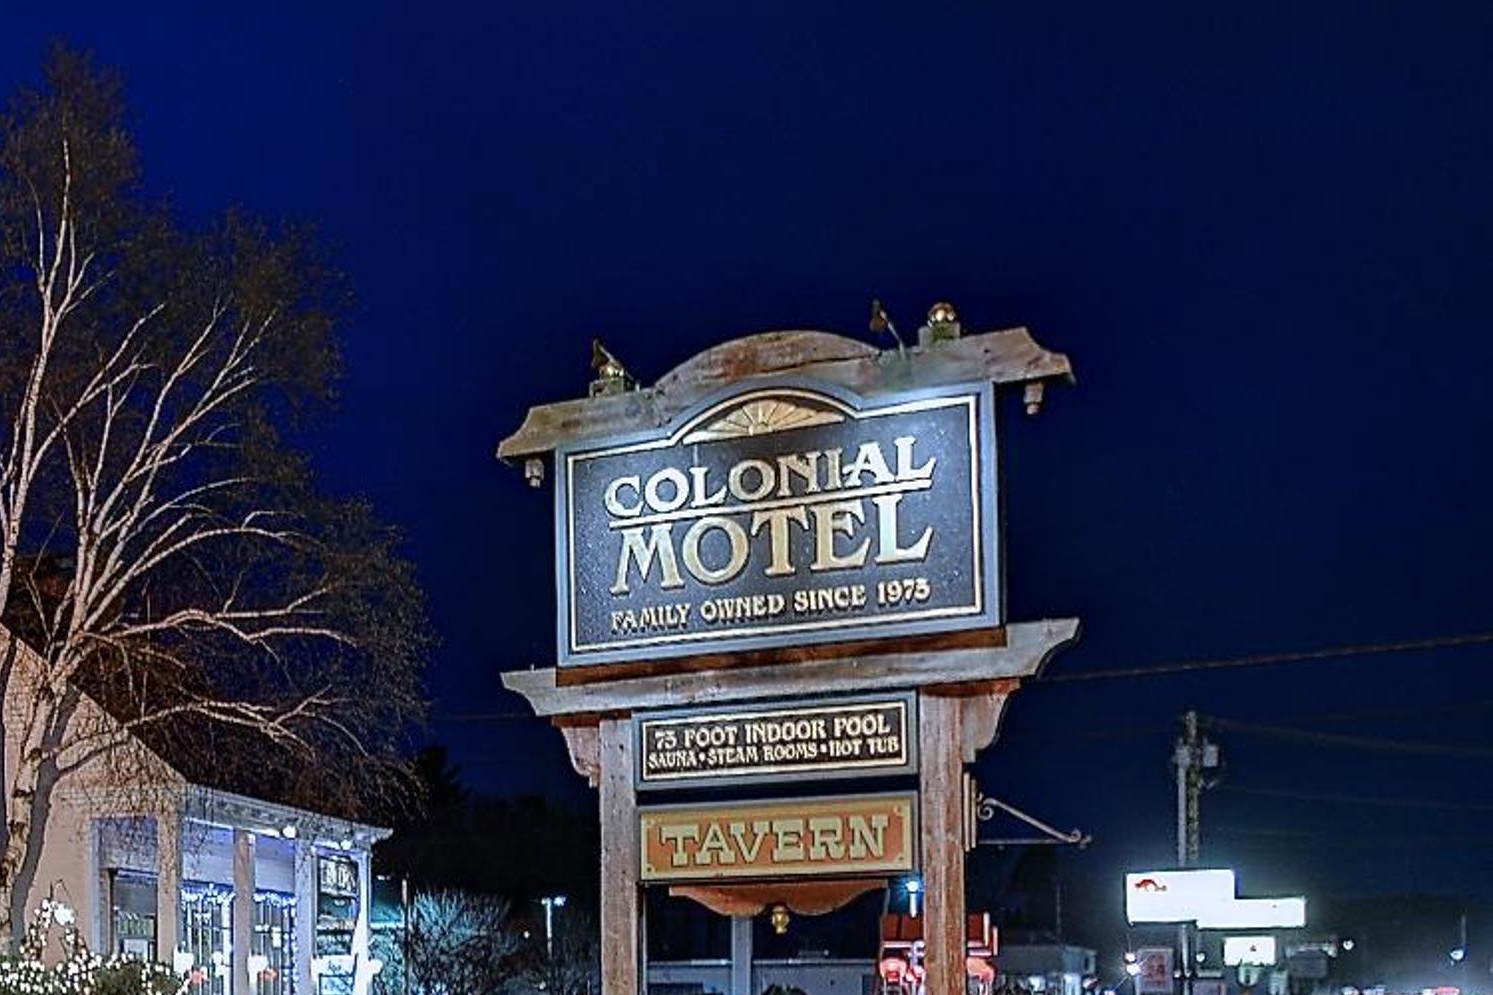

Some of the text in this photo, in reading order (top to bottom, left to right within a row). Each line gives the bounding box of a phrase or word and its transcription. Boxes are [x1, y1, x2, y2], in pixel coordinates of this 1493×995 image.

[605, 437, 935, 518] COLONIAL
[611, 493, 933, 597] MOTEL
[611, 579, 931, 631] FAMILY OWNED SINCE 1975
[648, 736, 899, 769] SAUNA STEAM ROOMS HOT TUB
[655, 714, 890, 749] 75 FOOT INDOOR POOL
[661, 814, 889, 867] TAVERN
